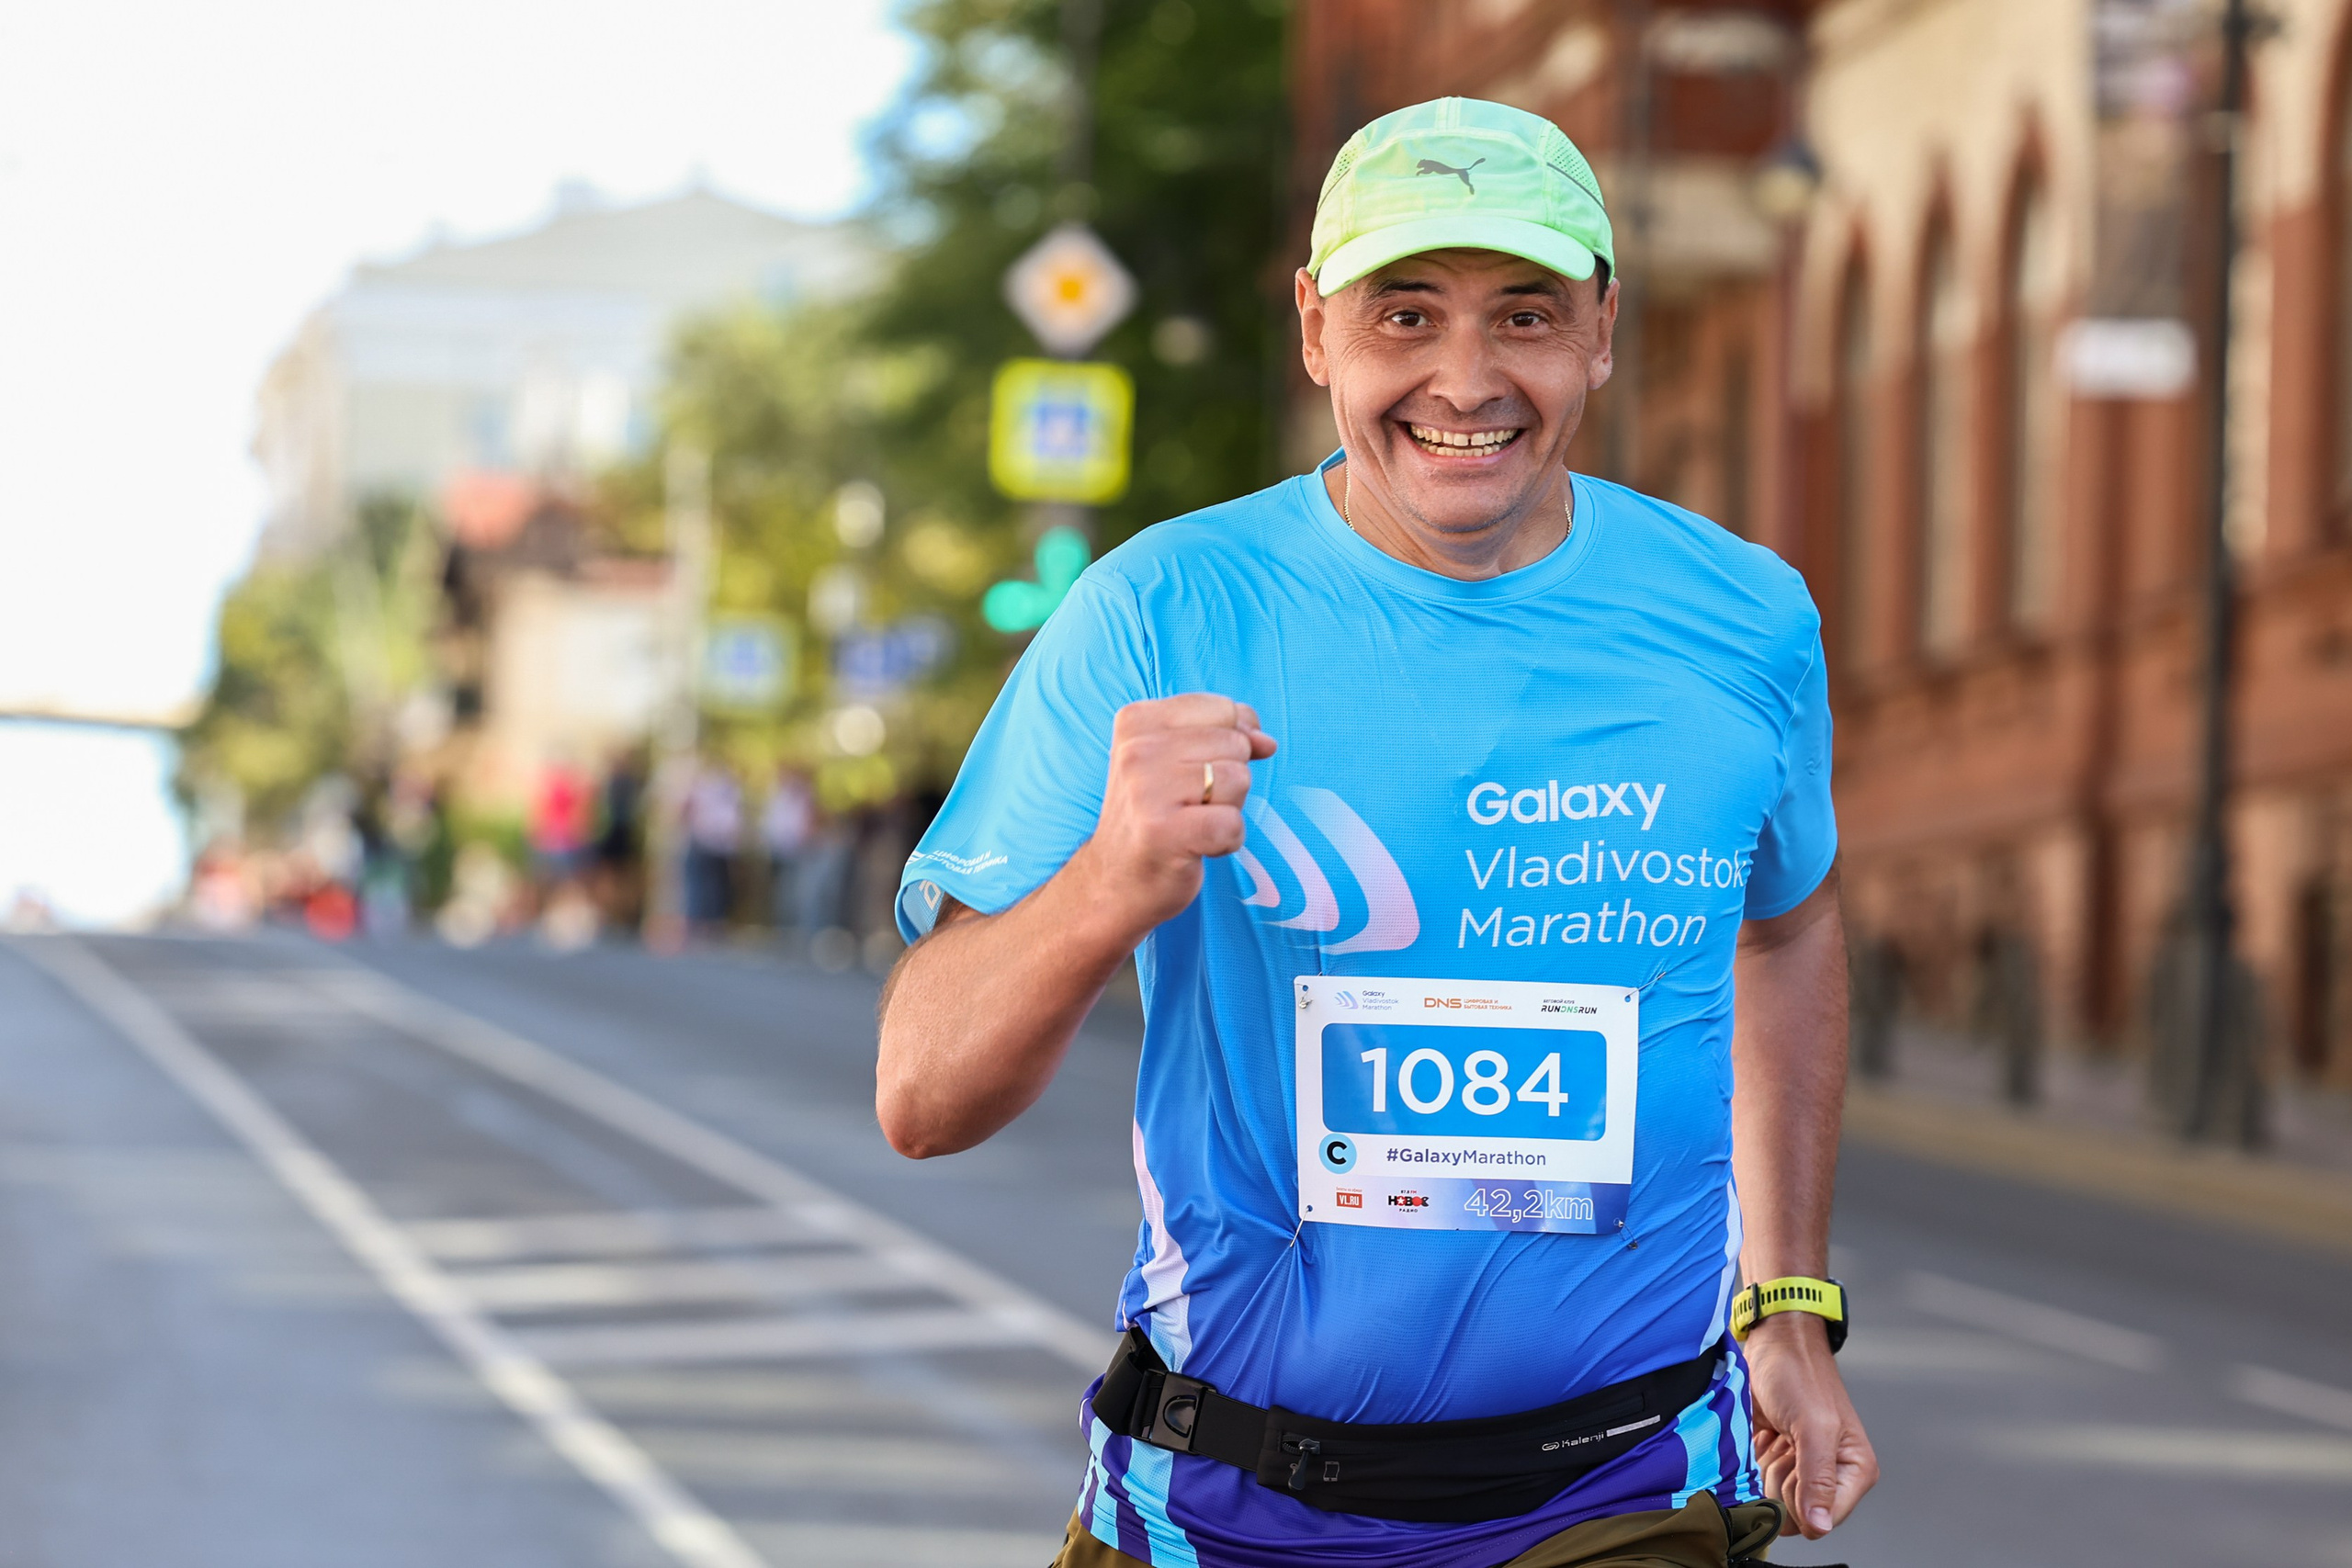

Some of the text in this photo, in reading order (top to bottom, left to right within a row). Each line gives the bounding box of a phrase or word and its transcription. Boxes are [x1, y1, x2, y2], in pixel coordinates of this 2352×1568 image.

[1466, 779, 1668, 831] Galaxy
[1464, 840, 1747, 890] Vladivostok
[1457, 897, 1707, 949] Marathon
[1362, 989, 1385, 998] Galaxy
[1424, 998, 1462, 1009] DNS
[1360, 1047, 1569, 1117] 1084
[1327, 1140, 1348, 1165] C
[1386, 1148, 1546, 1166] #GalaxyMarathon
[1339, 1194, 1360, 1206] VL.RU
[1464, 1188, 1594, 1224] 42,2km
[1562, 1431, 1605, 1448] Kalenji
